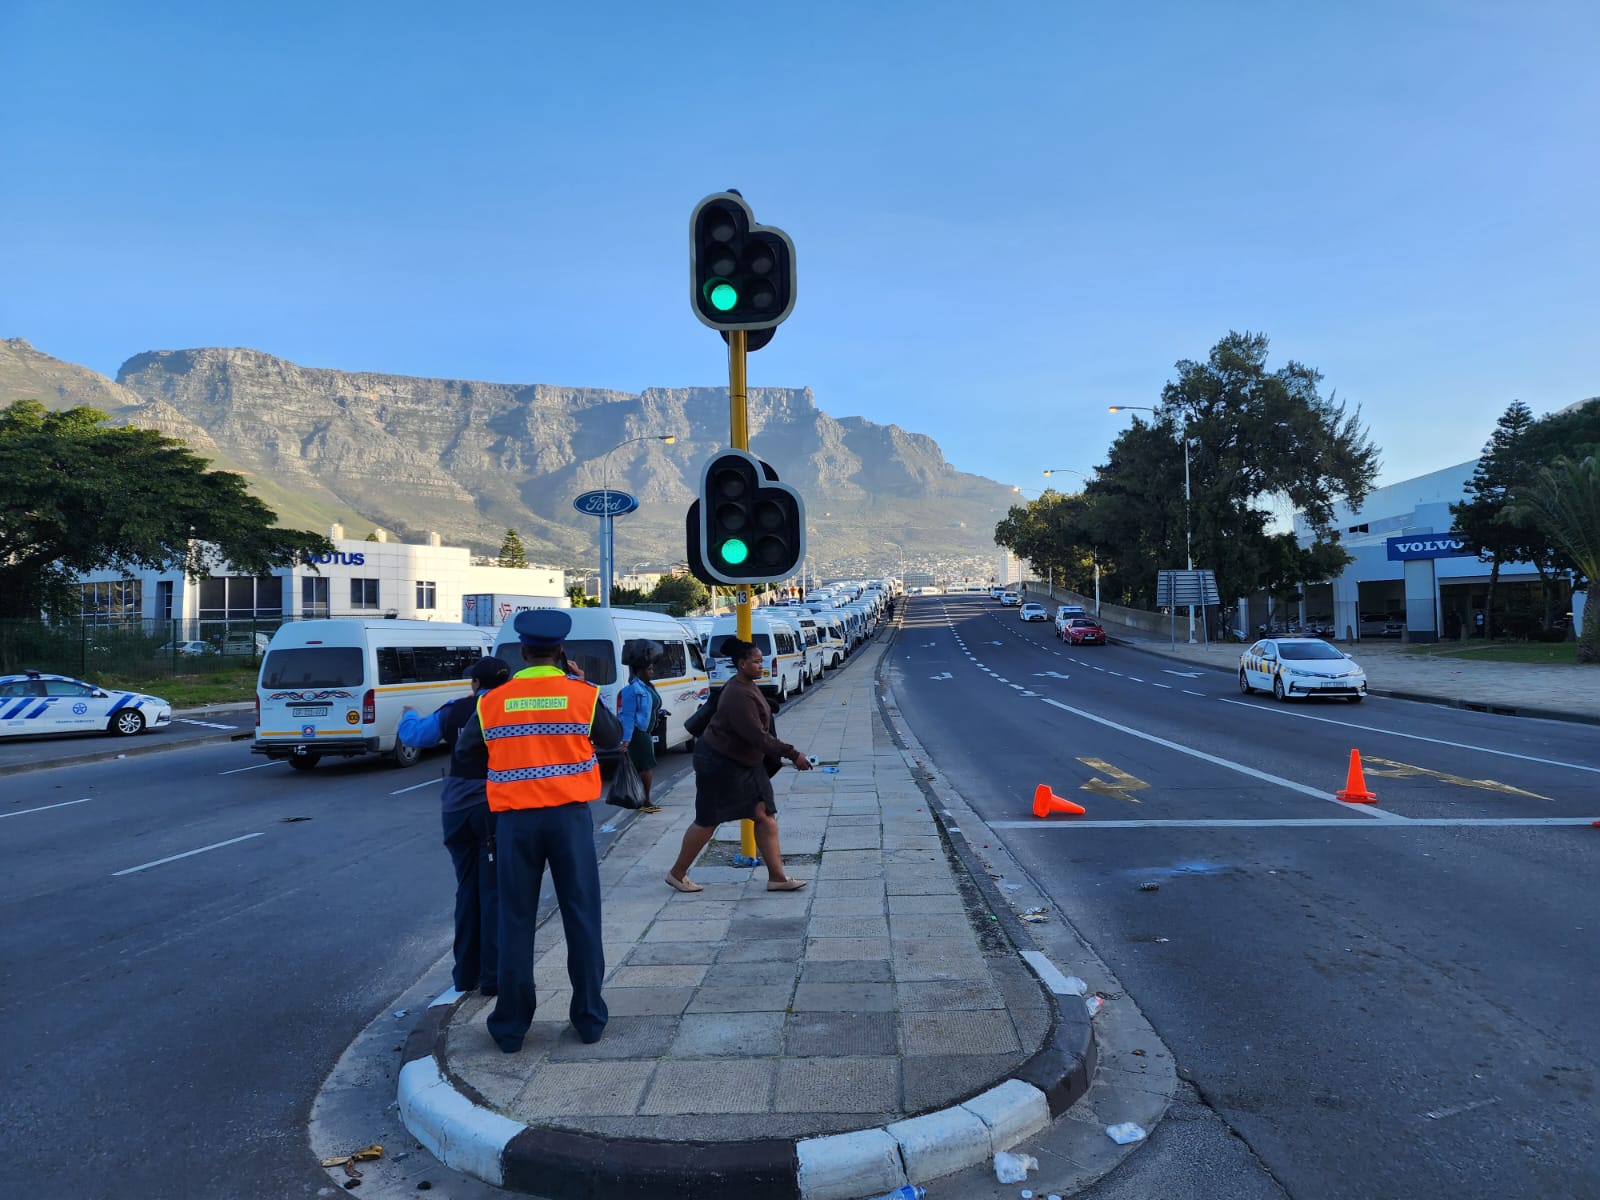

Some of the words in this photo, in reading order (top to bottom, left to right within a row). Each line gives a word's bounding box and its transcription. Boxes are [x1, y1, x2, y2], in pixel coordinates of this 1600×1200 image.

[1395, 540, 1465, 553] VOLVO
[738, 591, 747, 603] 13
[505, 699, 519, 710] LAW
[521, 697, 566, 709] ENFORCEMENT
